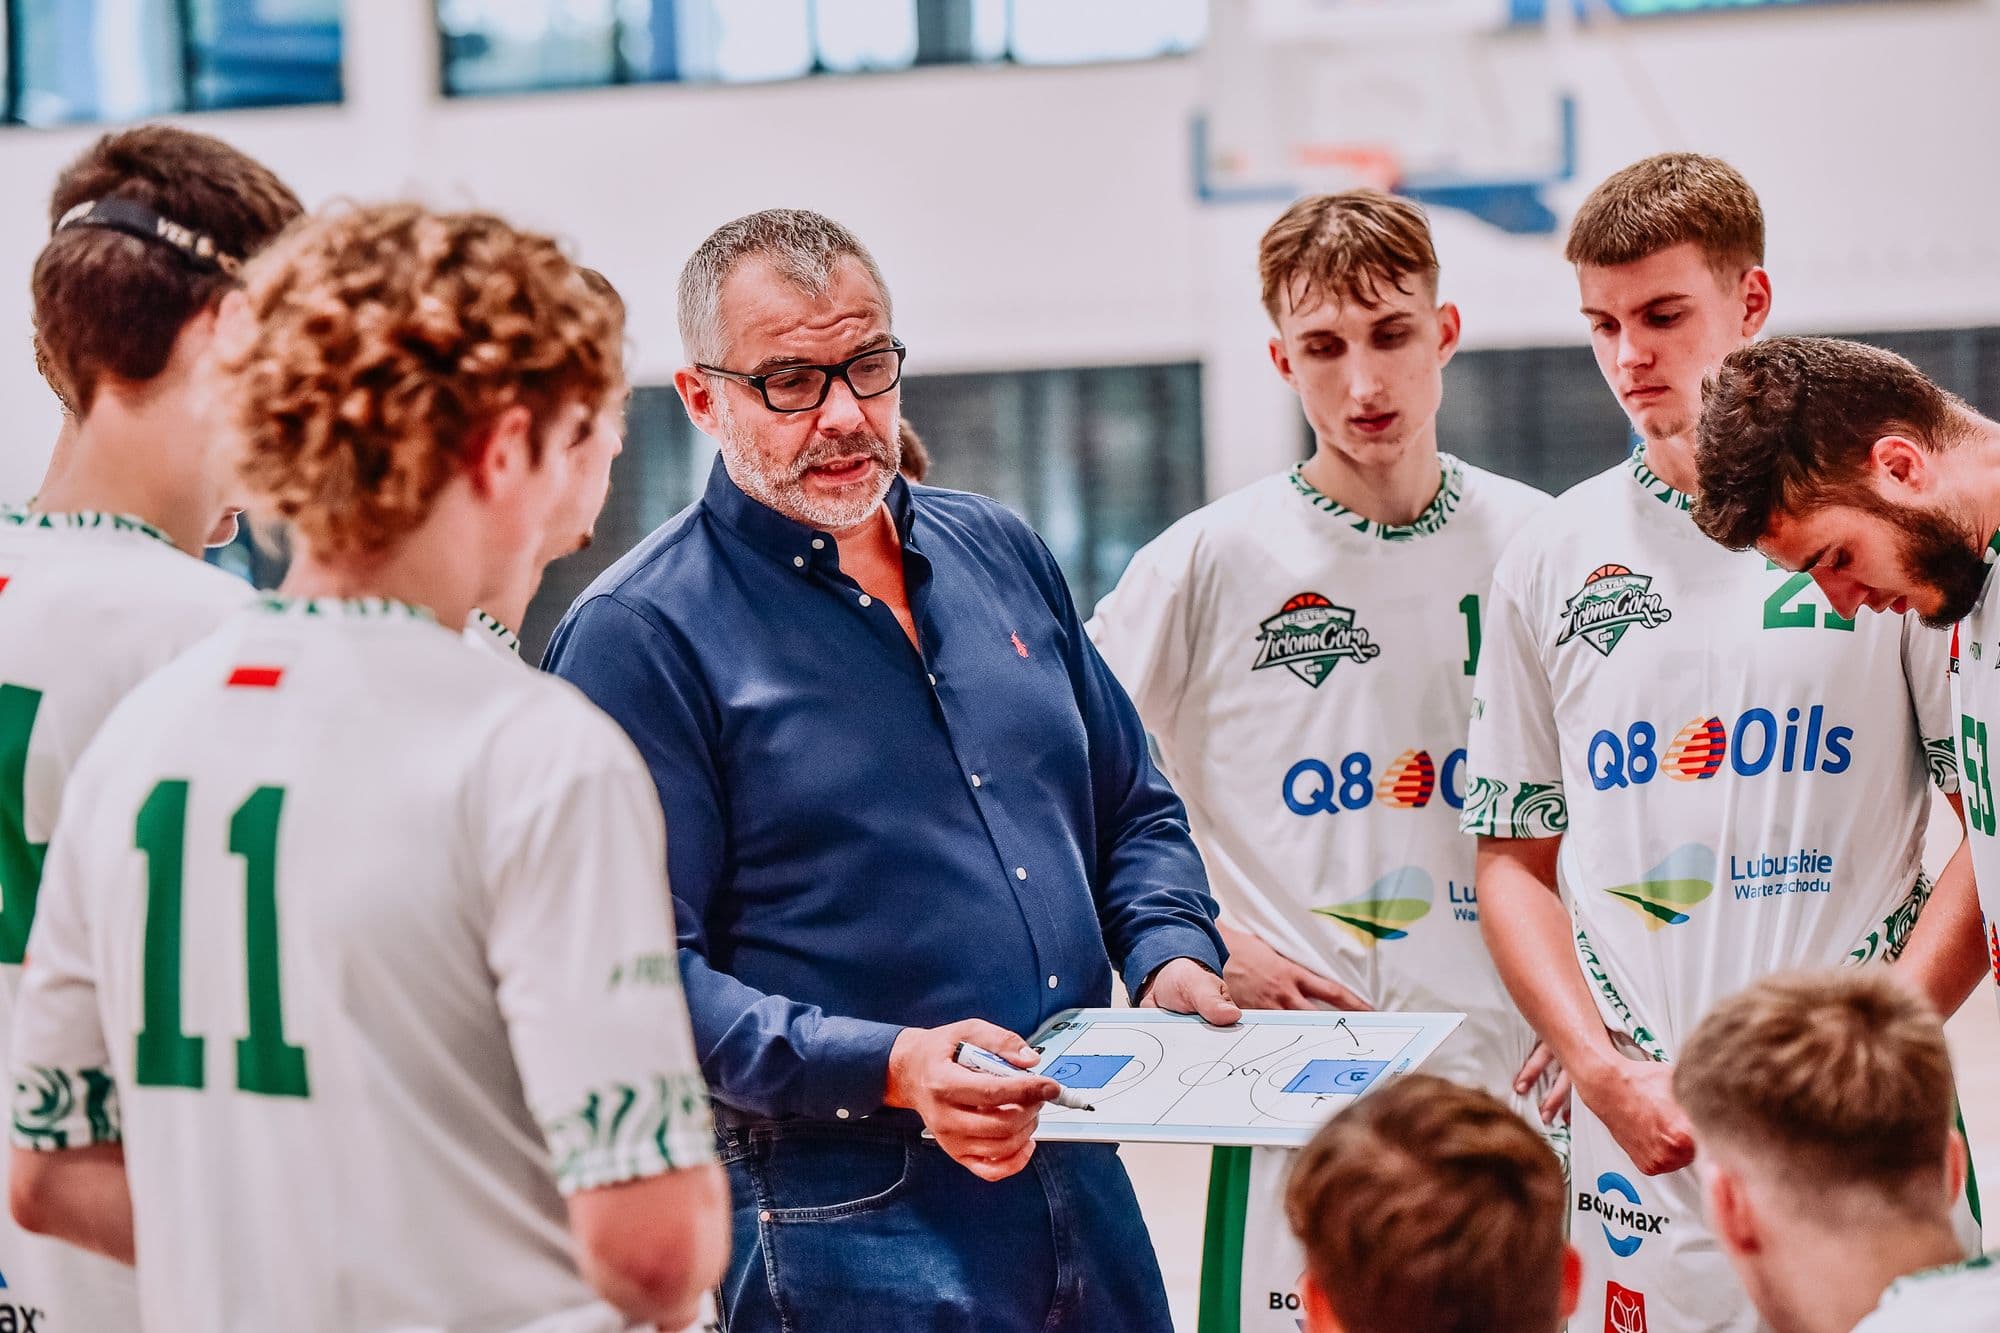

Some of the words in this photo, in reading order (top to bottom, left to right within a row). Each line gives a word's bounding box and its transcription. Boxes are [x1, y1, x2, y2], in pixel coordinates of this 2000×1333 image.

[1283, 752, 1373, 816] Q8
[1588, 721, 1657, 790] Q8
[1730, 704, 1854, 777] Oils
[1961, 714, 1996, 837] 53
[1731, 849, 1833, 881] Lubuskie
[136, 780, 311, 1099] 11
